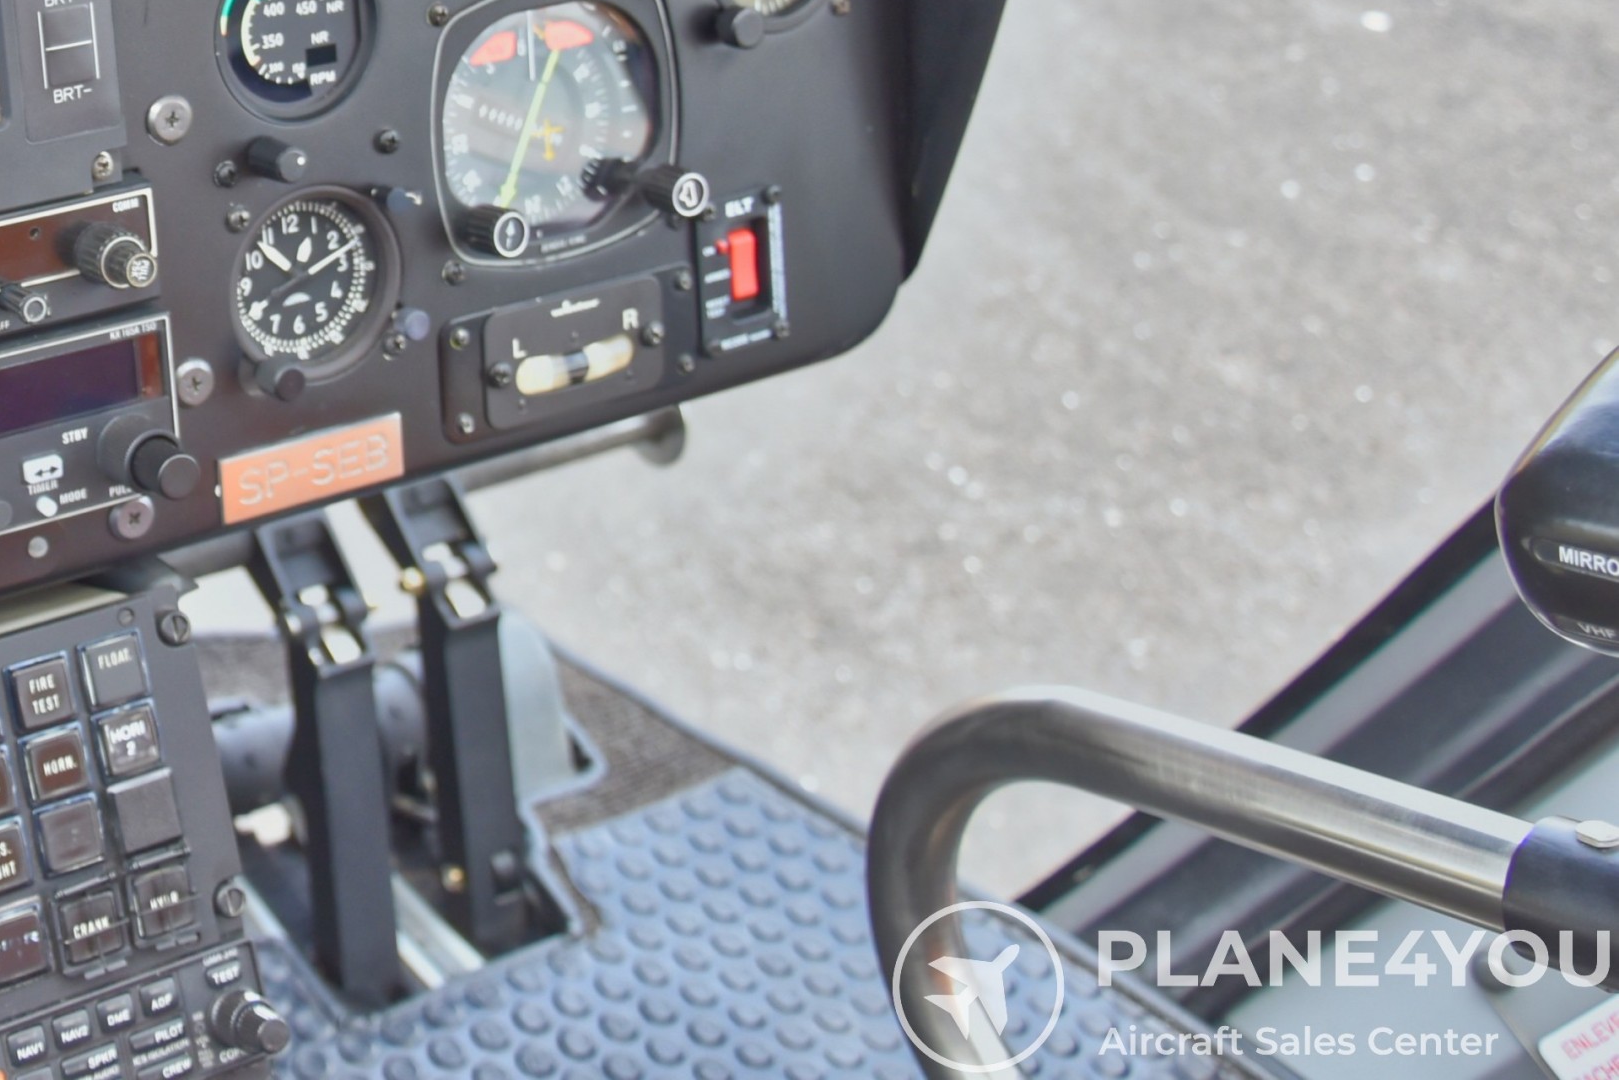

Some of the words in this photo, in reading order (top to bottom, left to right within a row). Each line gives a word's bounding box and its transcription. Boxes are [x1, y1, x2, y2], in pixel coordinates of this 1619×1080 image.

[263, 1, 285, 17] 400
[295, 0, 317, 16] 450
[326, 0, 344, 14] NR
[262, 32, 284, 50] 350
[311, 31, 329, 45] NR
[310, 70, 336, 85] RPM
[112, 198, 139, 213] COMM
[282, 214, 300, 235] 12
[327, 230, 339, 250] 2
[245, 250, 264, 270] 10
[239, 277, 253, 296] 9
[331, 281, 343, 299] 4
[315, 301, 328, 322] 5
[622, 308, 639, 330] R
[269, 314, 281, 334] 7
[293, 314, 305, 335] 6
[512, 337, 528, 359] L
[62, 428, 88, 445] STBY
[238, 433, 390, 505] SP-SEB
[59, 488, 88, 505] MODE
[30, 673, 55, 694] FIRE
[33, 693, 60, 716] TEST
[155, 1022, 184, 1043] PILOT
[17, 1041, 45, 1061] NAV1
